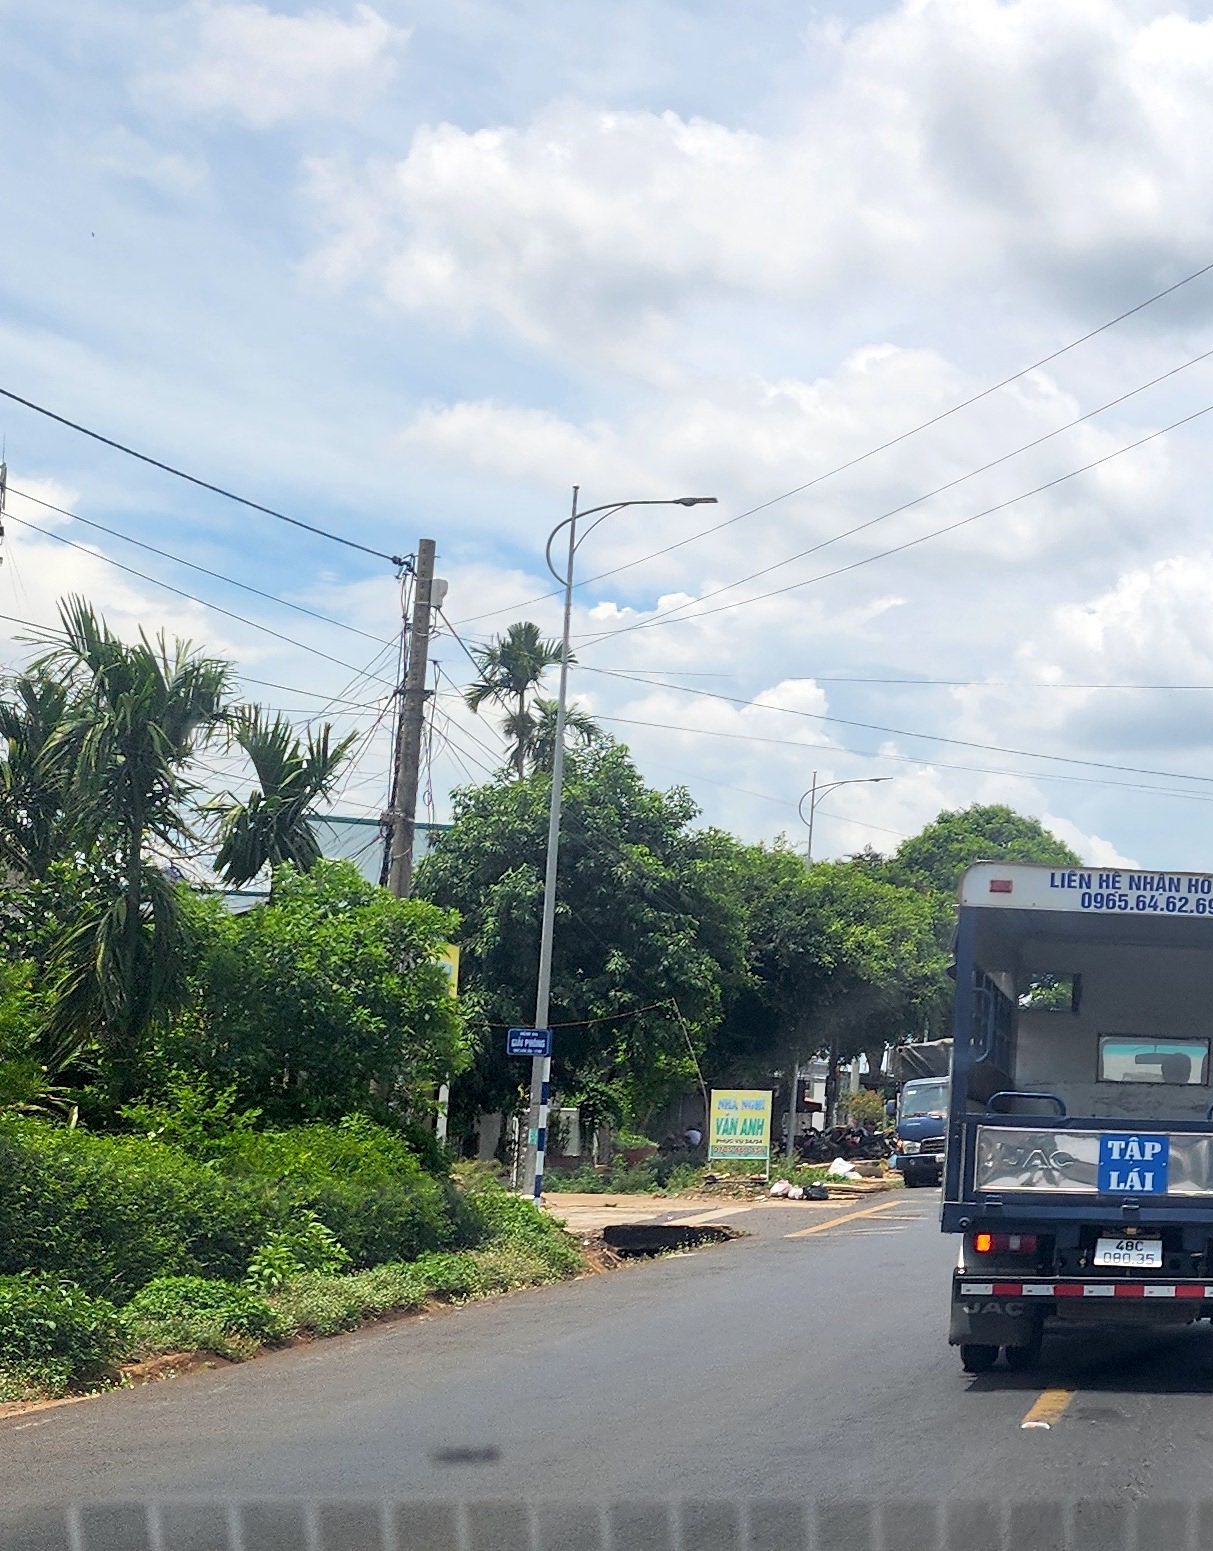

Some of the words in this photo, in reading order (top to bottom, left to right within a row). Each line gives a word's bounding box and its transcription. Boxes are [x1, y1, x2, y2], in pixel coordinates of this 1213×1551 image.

[1050, 870, 1092, 889] LIÊN
[1099, 871, 1122, 894] HỆ
[1129, 873, 1181, 896] NHẬN
[740, 1118, 765, 1136] ANH
[1107, 1136, 1162, 1165] TẬP
[1108, 1167, 1154, 1191] LÁI
[1116, 1240, 1144, 1252] 48C
[1103, 1252, 1155, 1265] 080.35
[967, 1302, 1024, 1316] JAC
